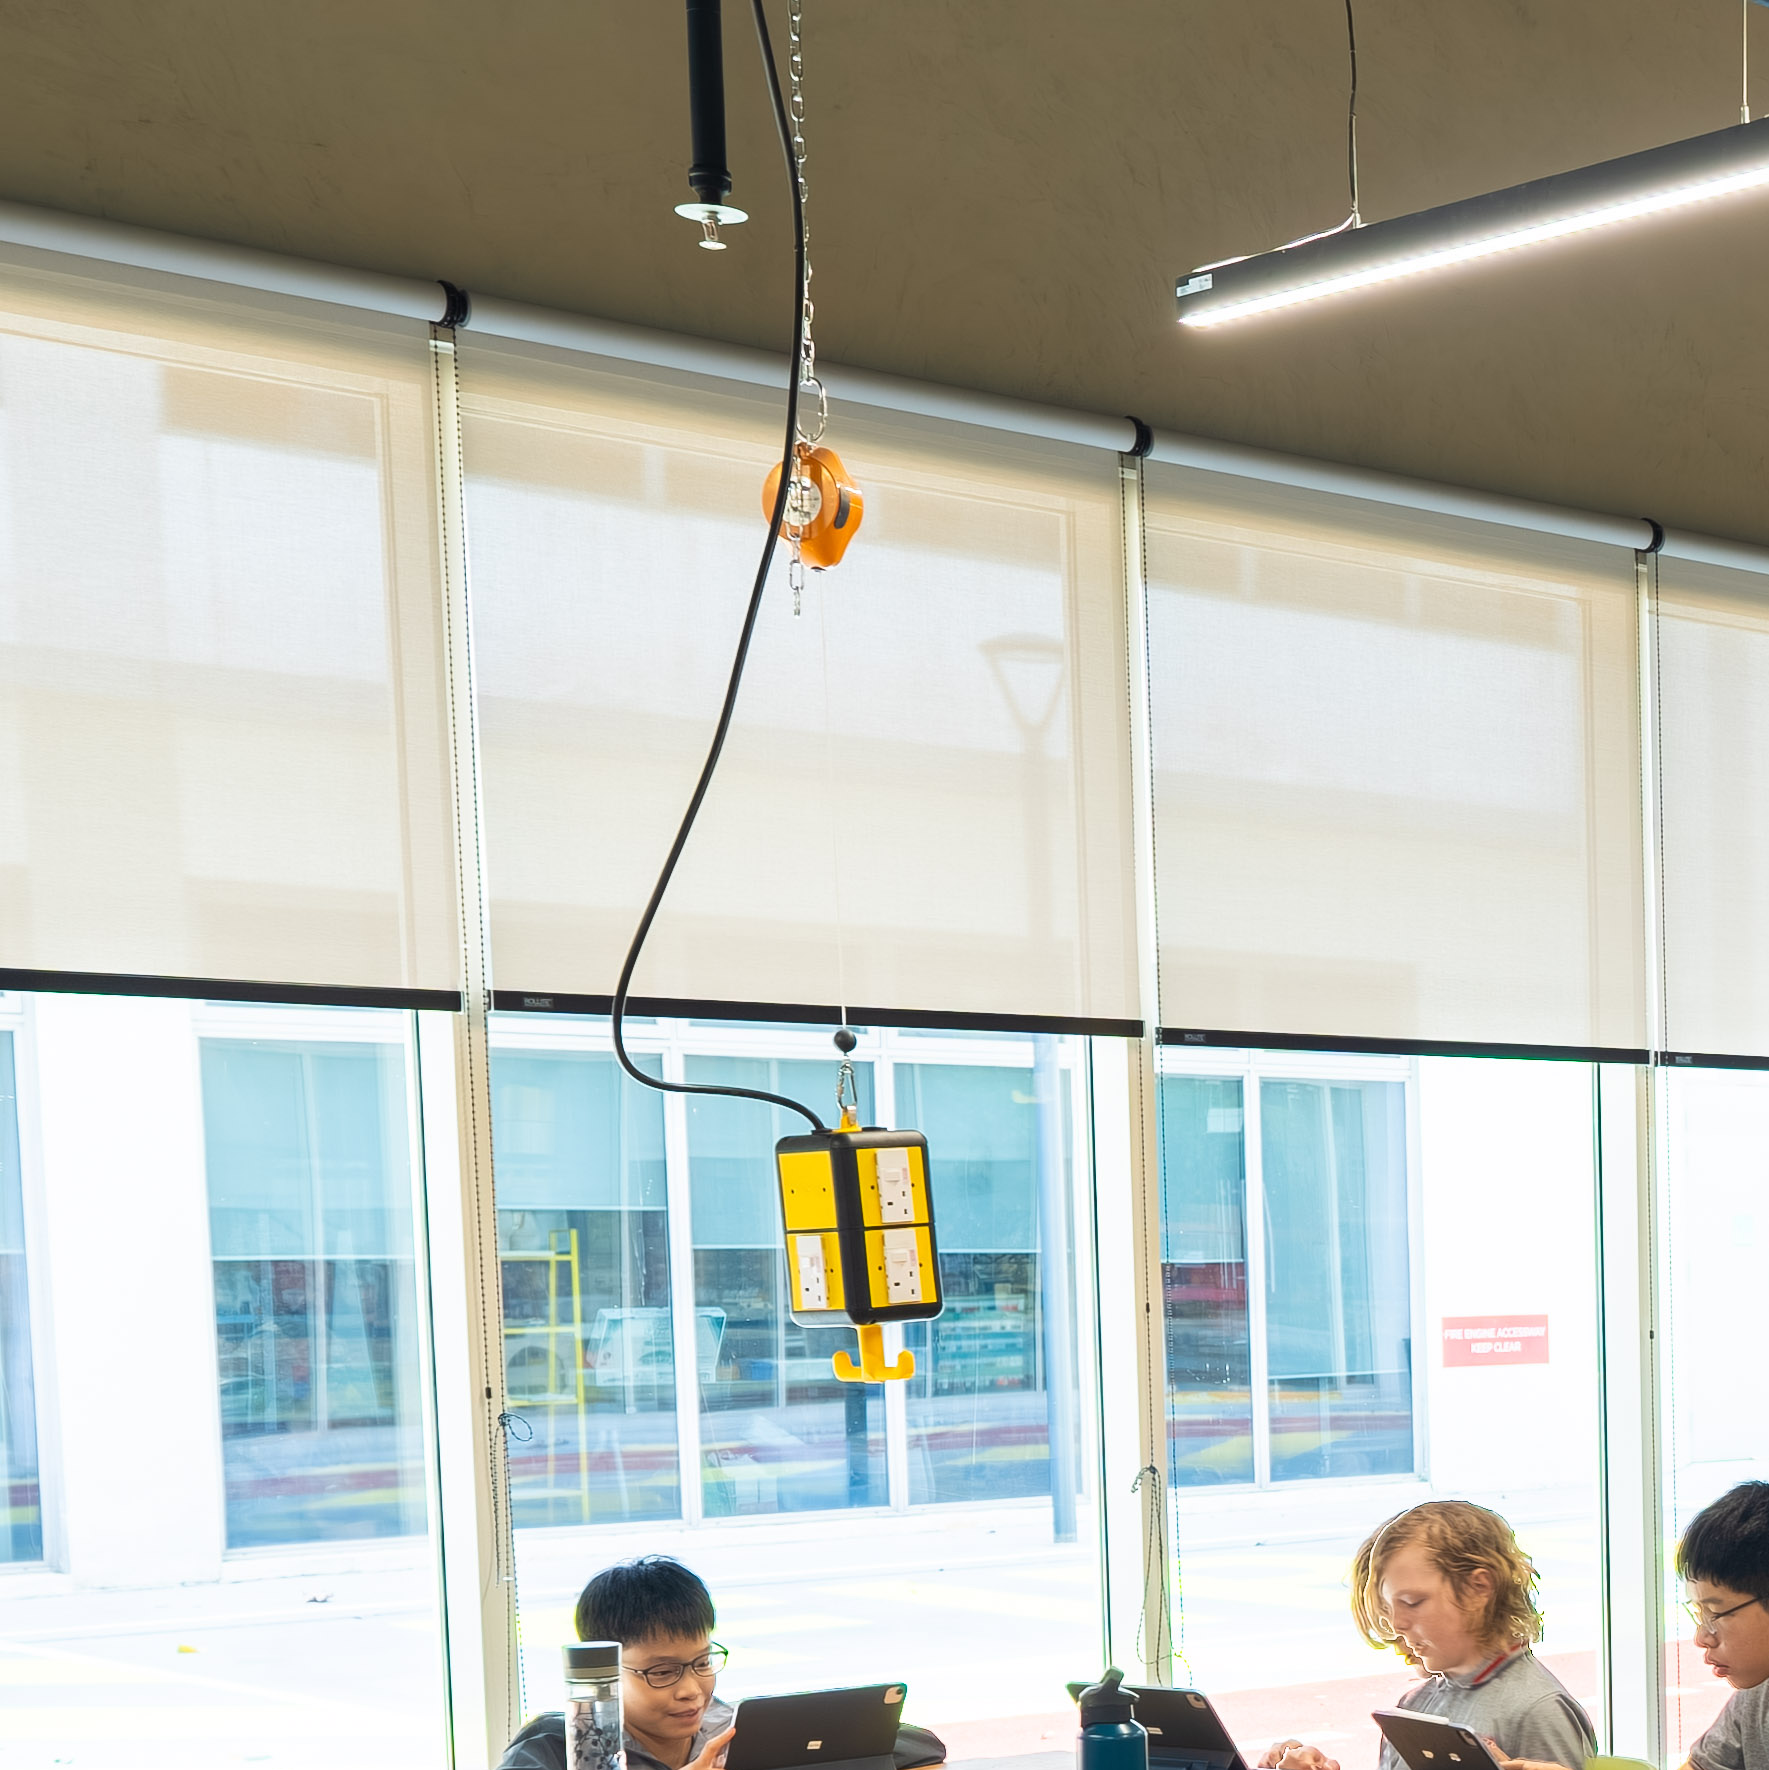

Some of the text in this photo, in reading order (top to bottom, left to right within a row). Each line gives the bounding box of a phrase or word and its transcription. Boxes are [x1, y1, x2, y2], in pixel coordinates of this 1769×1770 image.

[1444, 1329, 1463, 1340] FIRE
[1464, 1328, 1496, 1339] ENGINE
[1471, 1341, 1521, 1353] KEEP CLEAR
